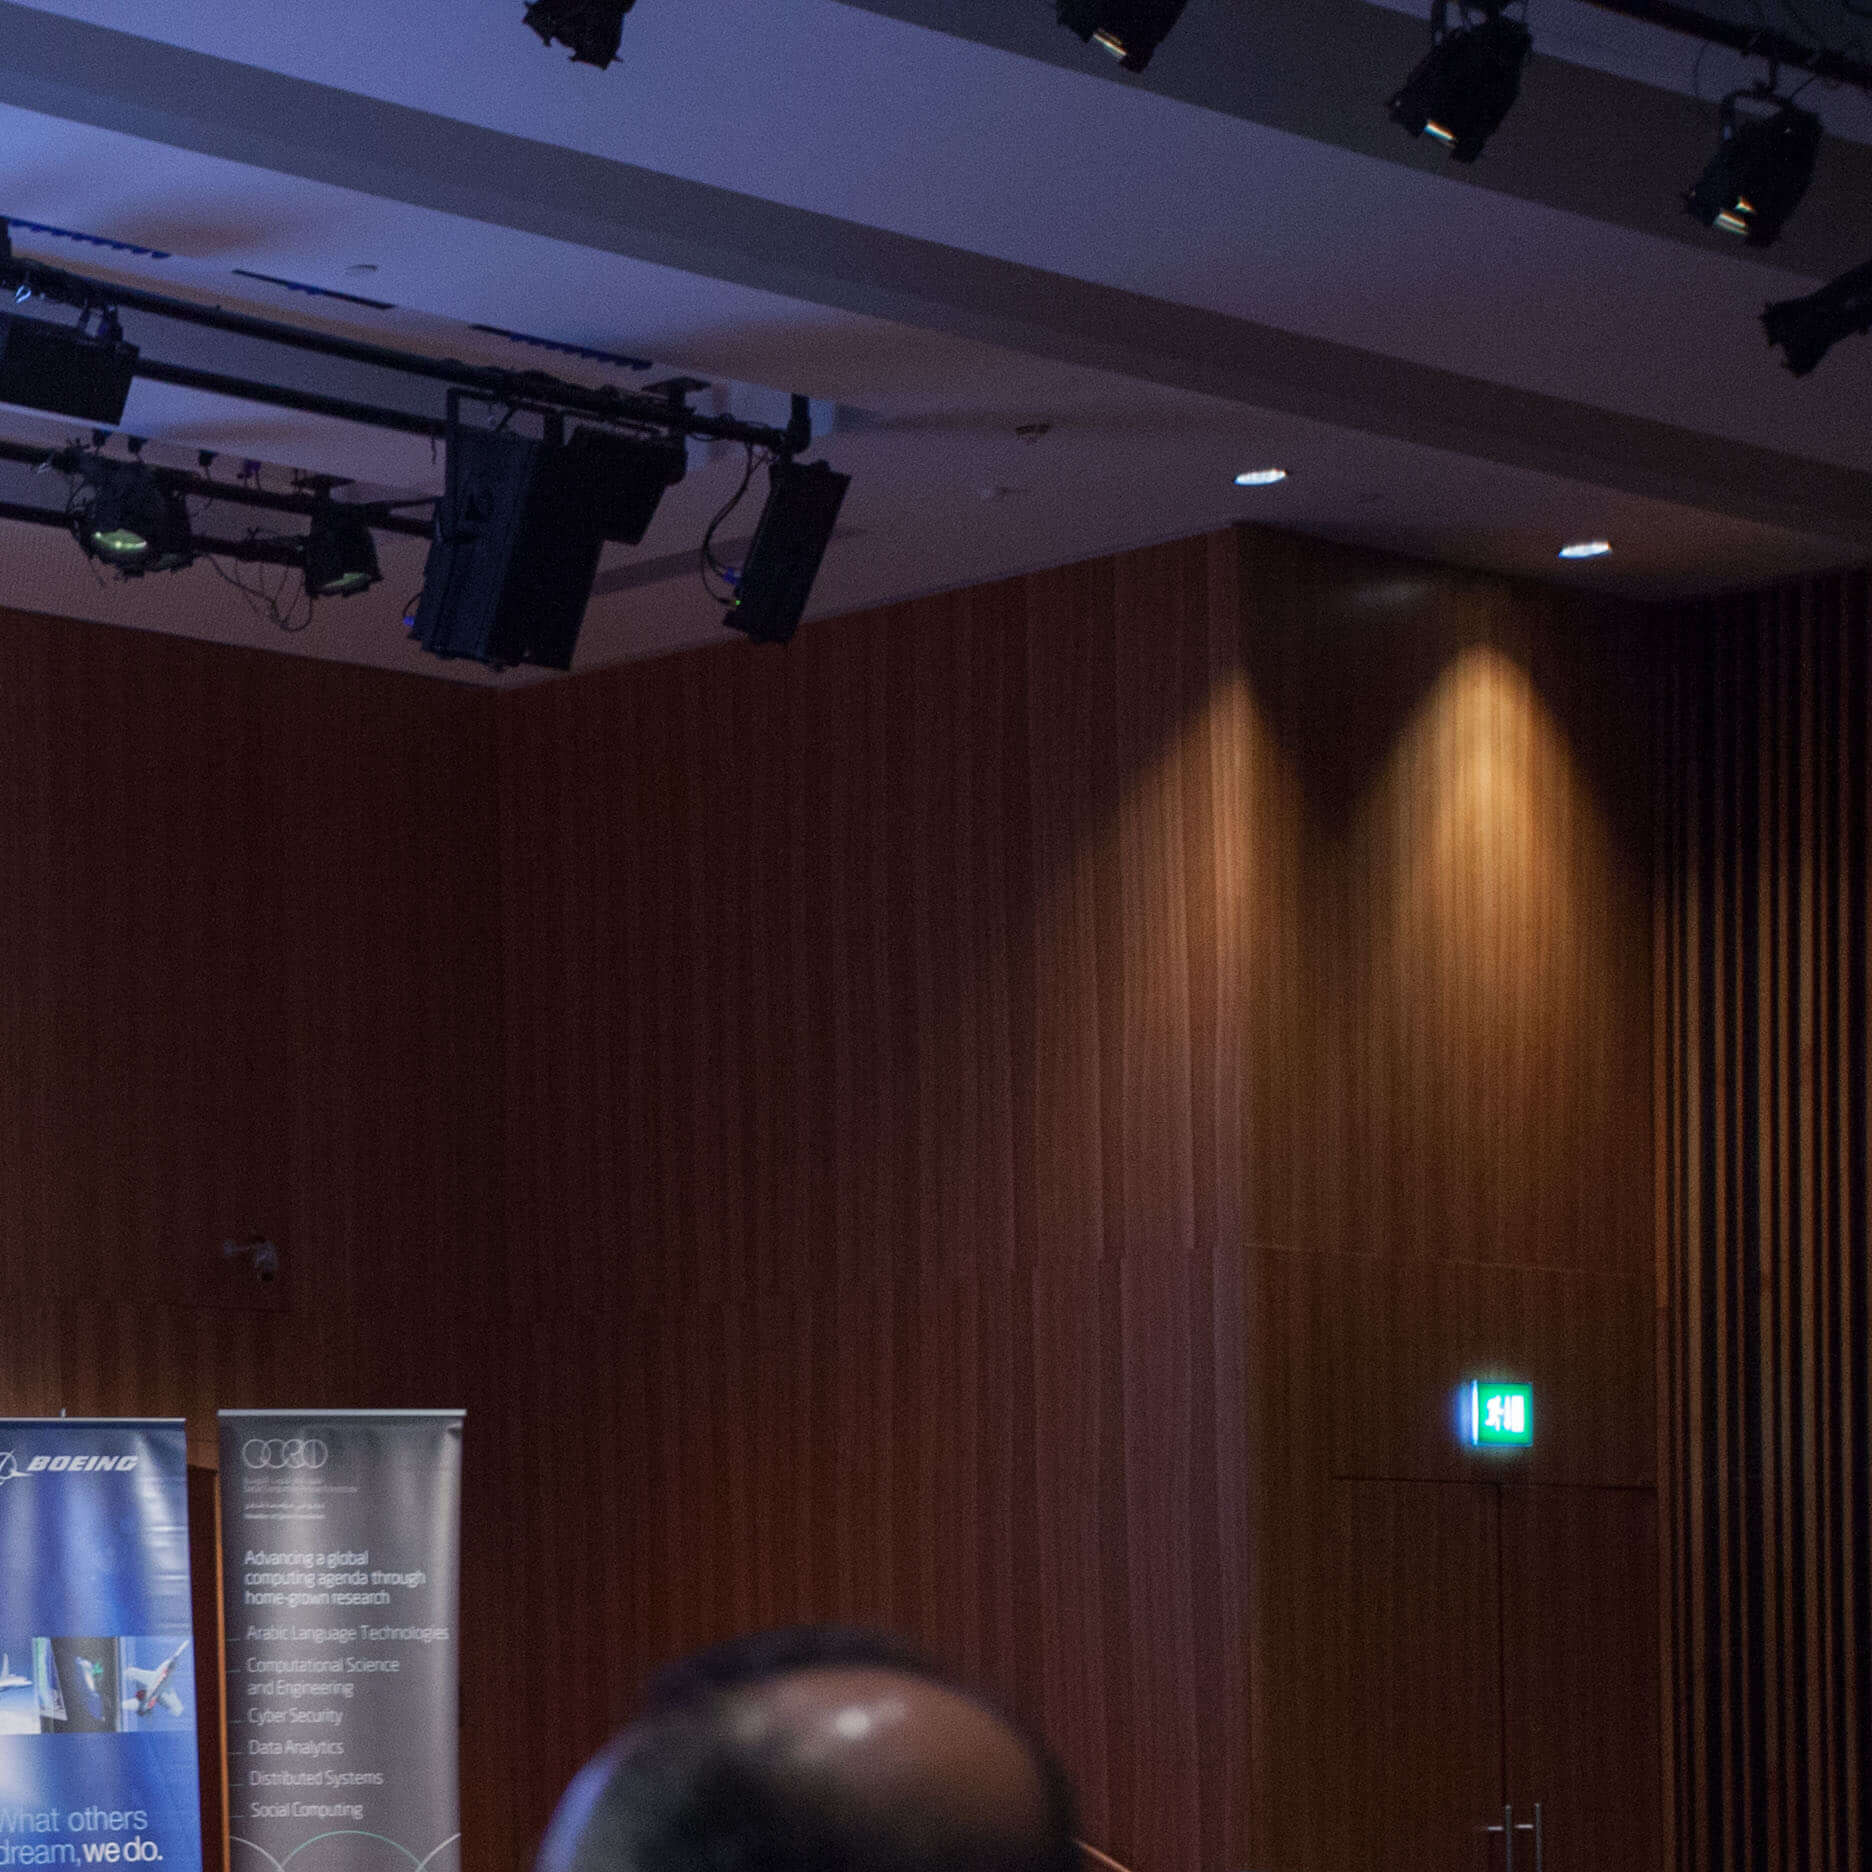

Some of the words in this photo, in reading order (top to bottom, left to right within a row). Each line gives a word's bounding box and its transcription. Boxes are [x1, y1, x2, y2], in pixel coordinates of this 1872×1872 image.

[27, 1455, 139, 1472] BOEING
[244, 1550, 315, 1569] Advancing
[316, 1554, 326, 1565] a
[327, 1550, 369, 1569] global
[244, 1571, 316, 1588] computing
[317, 1571, 369, 1588] agenda
[371, 1570, 426, 1588] through
[331, 1590, 391, 1605] research
[246, 1624, 289, 1641] Arabic
[291, 1625, 357, 1643] Language
[360, 1624, 449, 1643] Technologies
[246, 1657, 344, 1674] Computational
[346, 1657, 400, 1673] Science
[248, 1680, 274, 1695] and
[276, 1680, 355, 1698] Engineering
[247, 1707, 287, 1726] Cyber
[288, 1707, 344, 1726] Security
[248, 1739, 283, 1755] Data
[284, 1739, 345, 1758] Analytics
[249, 1770, 323, 1786] Distributed
[324, 1769, 384, 1788] Systems
[67, 1805, 149, 1832] others
[251, 1801, 290, 1818] Social
[292, 1801, 364, 1820] Computing
[81, 1841, 121, 1863] we
[123, 1835, 164, 1862] do.
